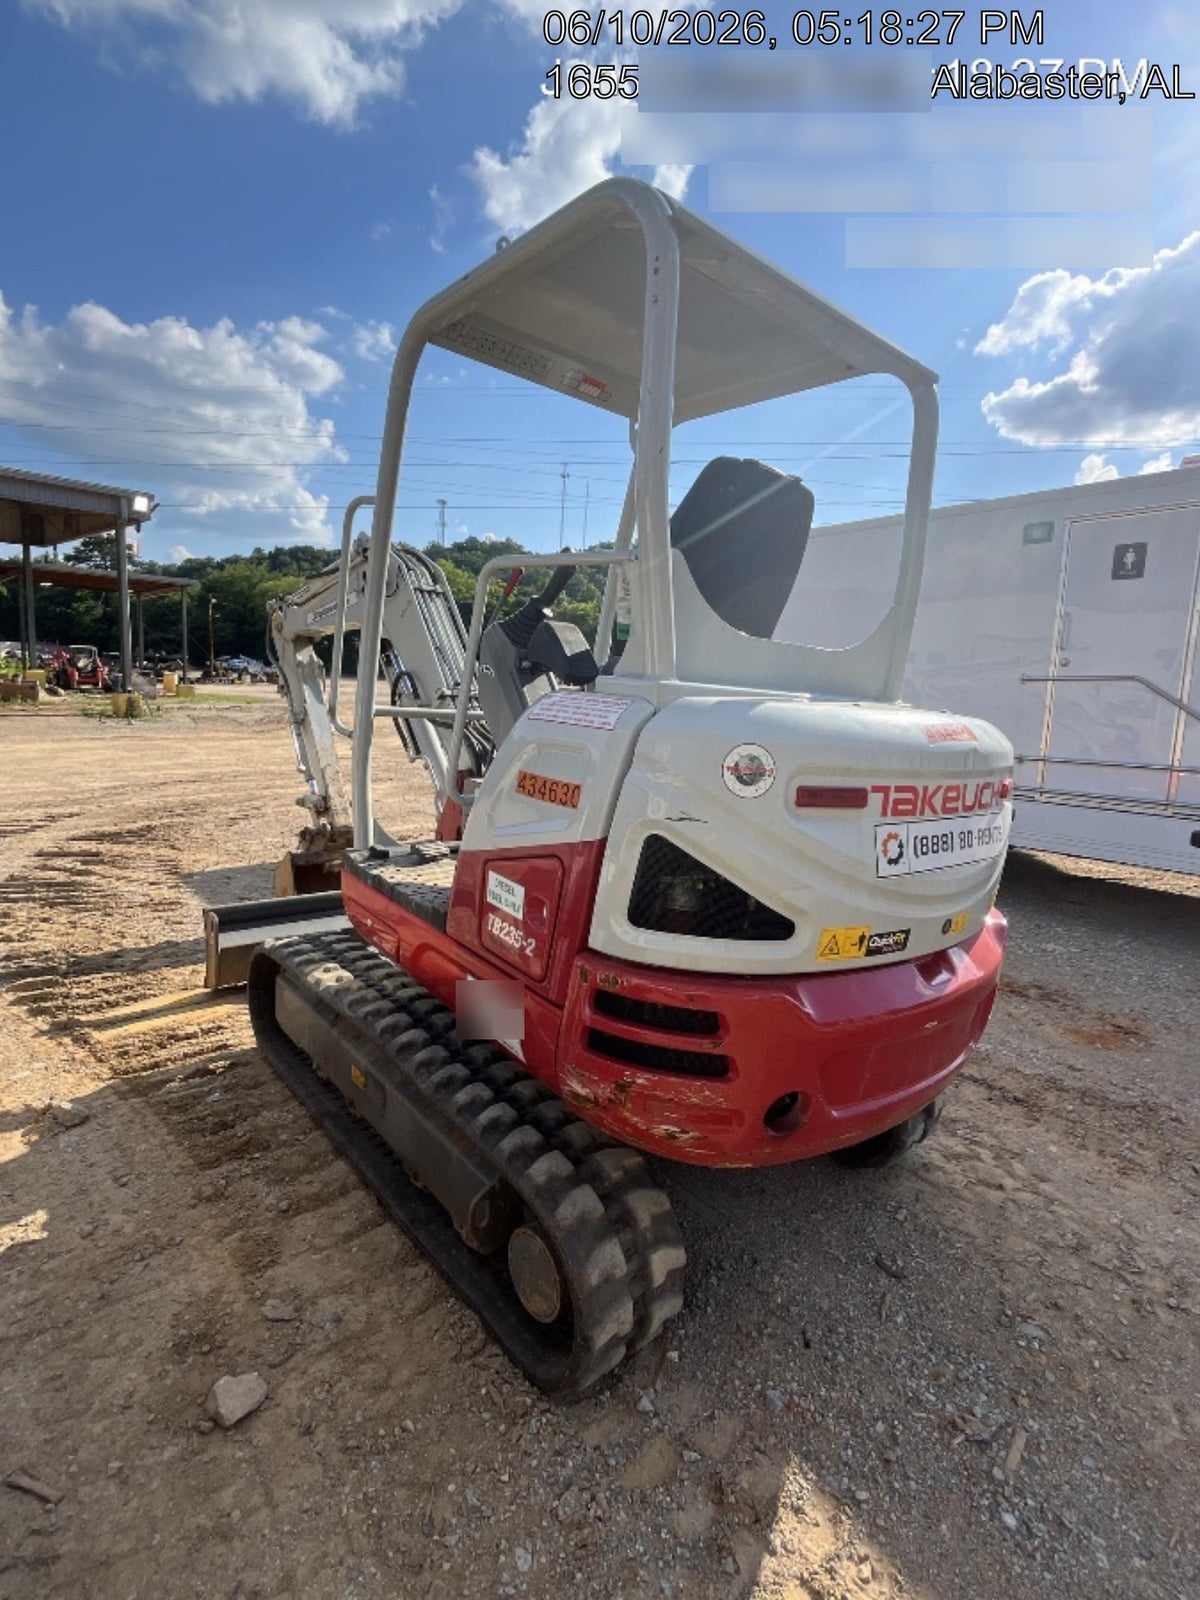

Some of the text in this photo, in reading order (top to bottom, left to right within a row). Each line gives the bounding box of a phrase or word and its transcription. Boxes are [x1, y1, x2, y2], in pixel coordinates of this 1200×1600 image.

[517, 772, 581, 809] 434630
[870, 782, 1001, 817] TAKEUCH
[913, 831, 954, 859] (888)
[488, 911, 536, 957] TB235-2
